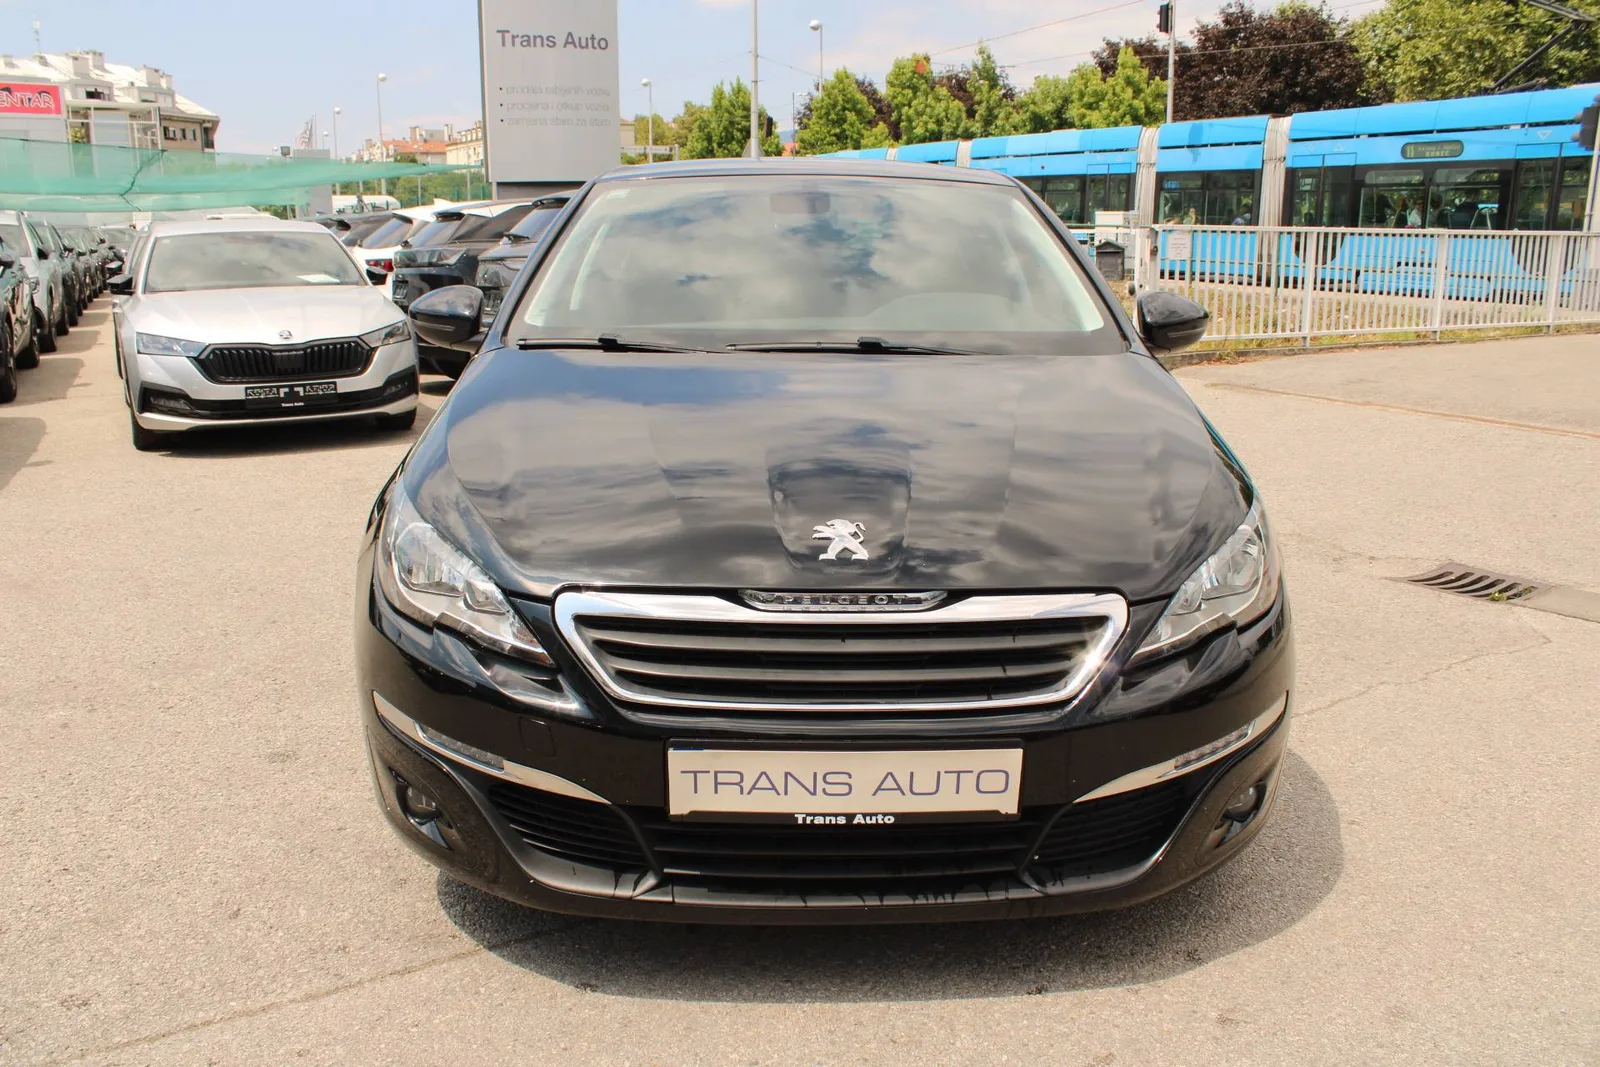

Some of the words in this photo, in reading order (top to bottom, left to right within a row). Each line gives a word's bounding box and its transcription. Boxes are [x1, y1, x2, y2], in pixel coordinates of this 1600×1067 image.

[496, 30, 556, 48] Trans
[563, 32, 609, 50] Auto
[783, 594, 907, 605] PEUGEOT
[680, 769, 853, 797] TRANS
[870, 768, 1010, 797] AUTO
[794, 813, 847, 825] Trans
[852, 813, 895, 825] Auto
